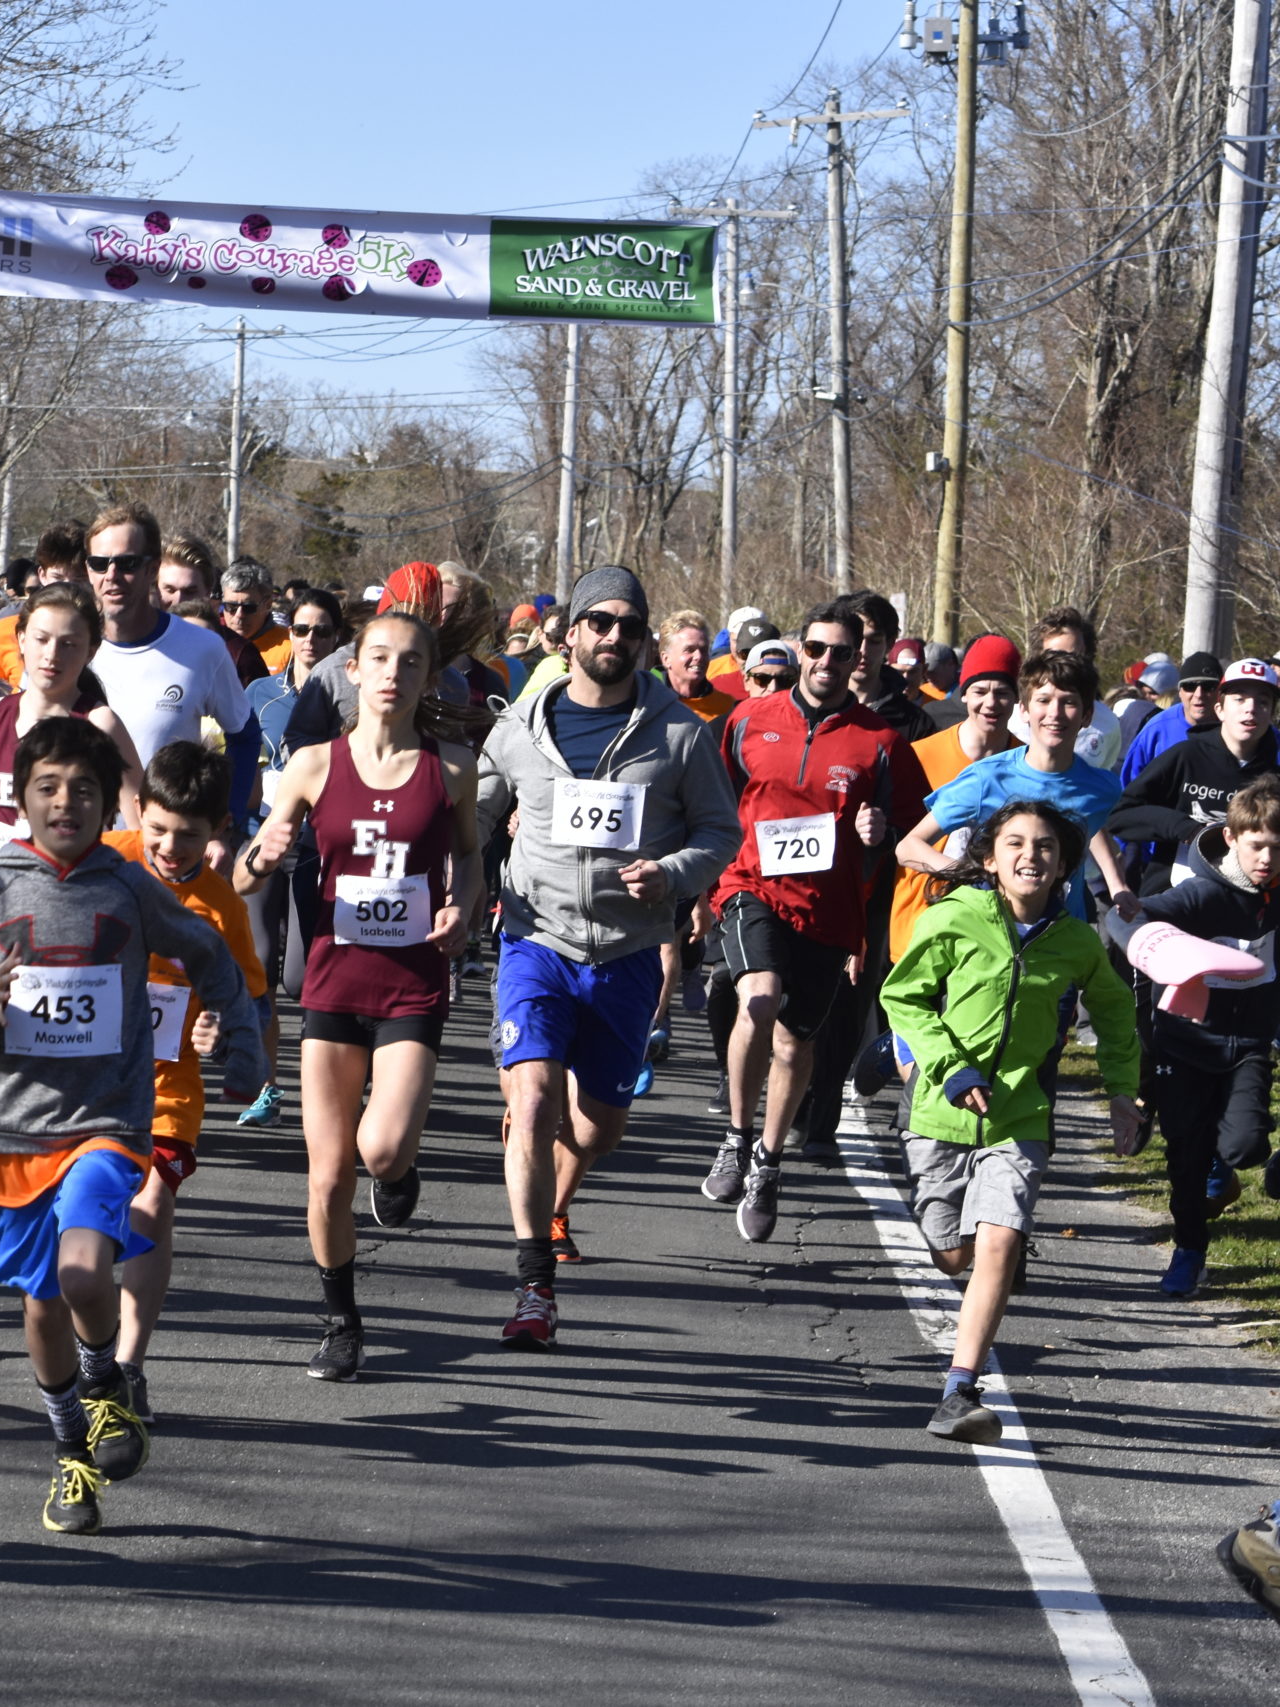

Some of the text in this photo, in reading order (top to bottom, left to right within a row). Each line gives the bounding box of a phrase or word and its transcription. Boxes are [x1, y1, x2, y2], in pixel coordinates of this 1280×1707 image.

[90, 230, 413, 278] Katy's Courage 5K
[522, 233, 692, 277] WAINSCOTT
[515, 275, 697, 301] SAND & GRAVEL
[523, 300, 550, 310] SOIL
[573, 302, 609, 312] STONE
[615, 304, 693, 315] SPECIALISTS
[1183, 782, 1224, 801] roger
[570, 806, 623, 833] 695
[774, 838, 821, 860] 720
[356, 900, 409, 922] 502
[361, 927, 406, 937] Isabella
[30, 994, 96, 1025] 453
[34, 1031, 93, 1045] Maxwell
